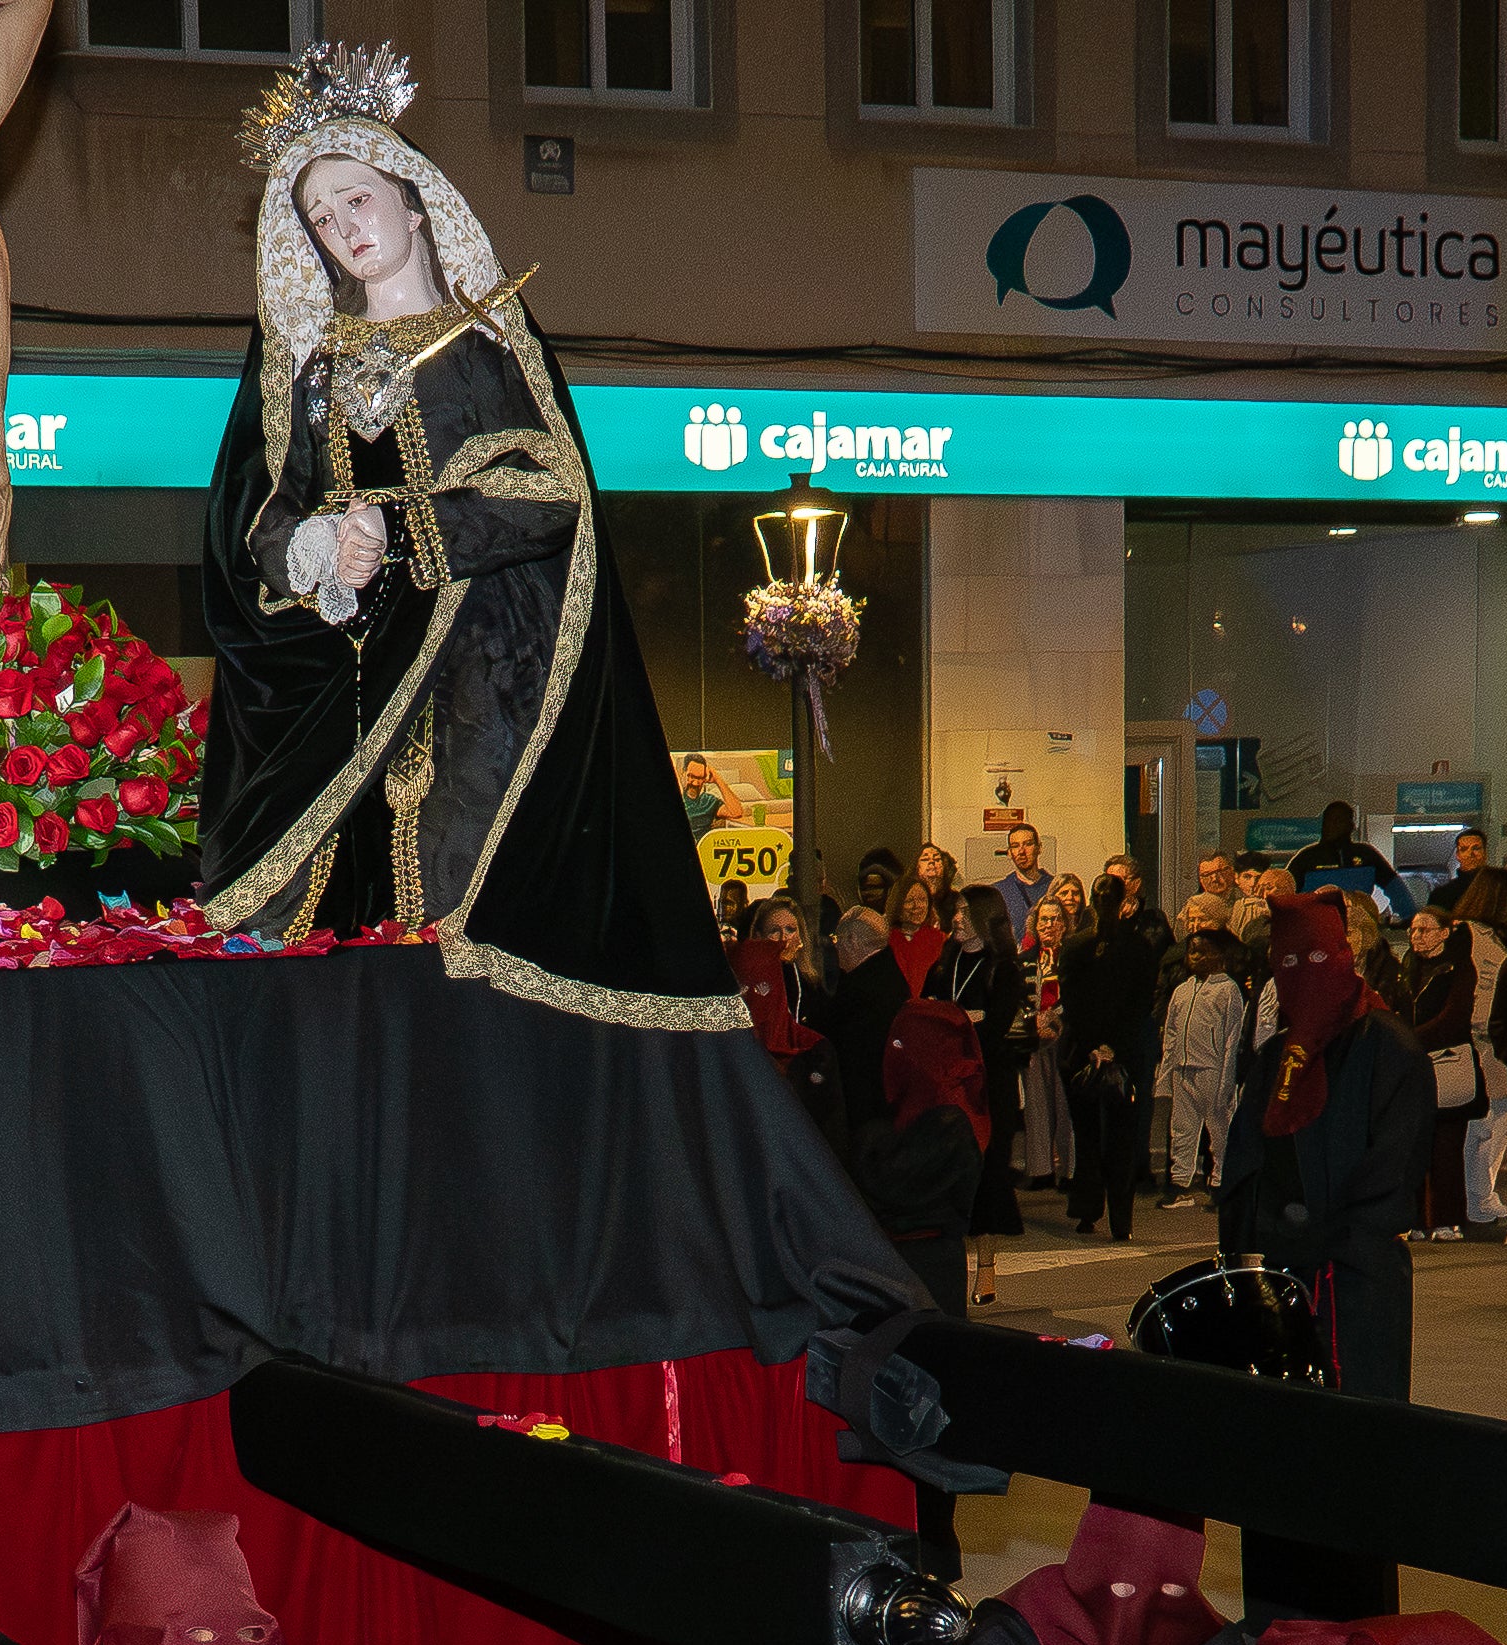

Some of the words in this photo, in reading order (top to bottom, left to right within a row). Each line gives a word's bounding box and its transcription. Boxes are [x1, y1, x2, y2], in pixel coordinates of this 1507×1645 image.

[1176, 203, 1501, 292] mayéutica
[1175, 291, 1500, 328] CONSULTORES
[759, 410, 954, 474] cajamar
[855, 461, 895, 478] CAJA
[898, 462, 949, 478] RURAL
